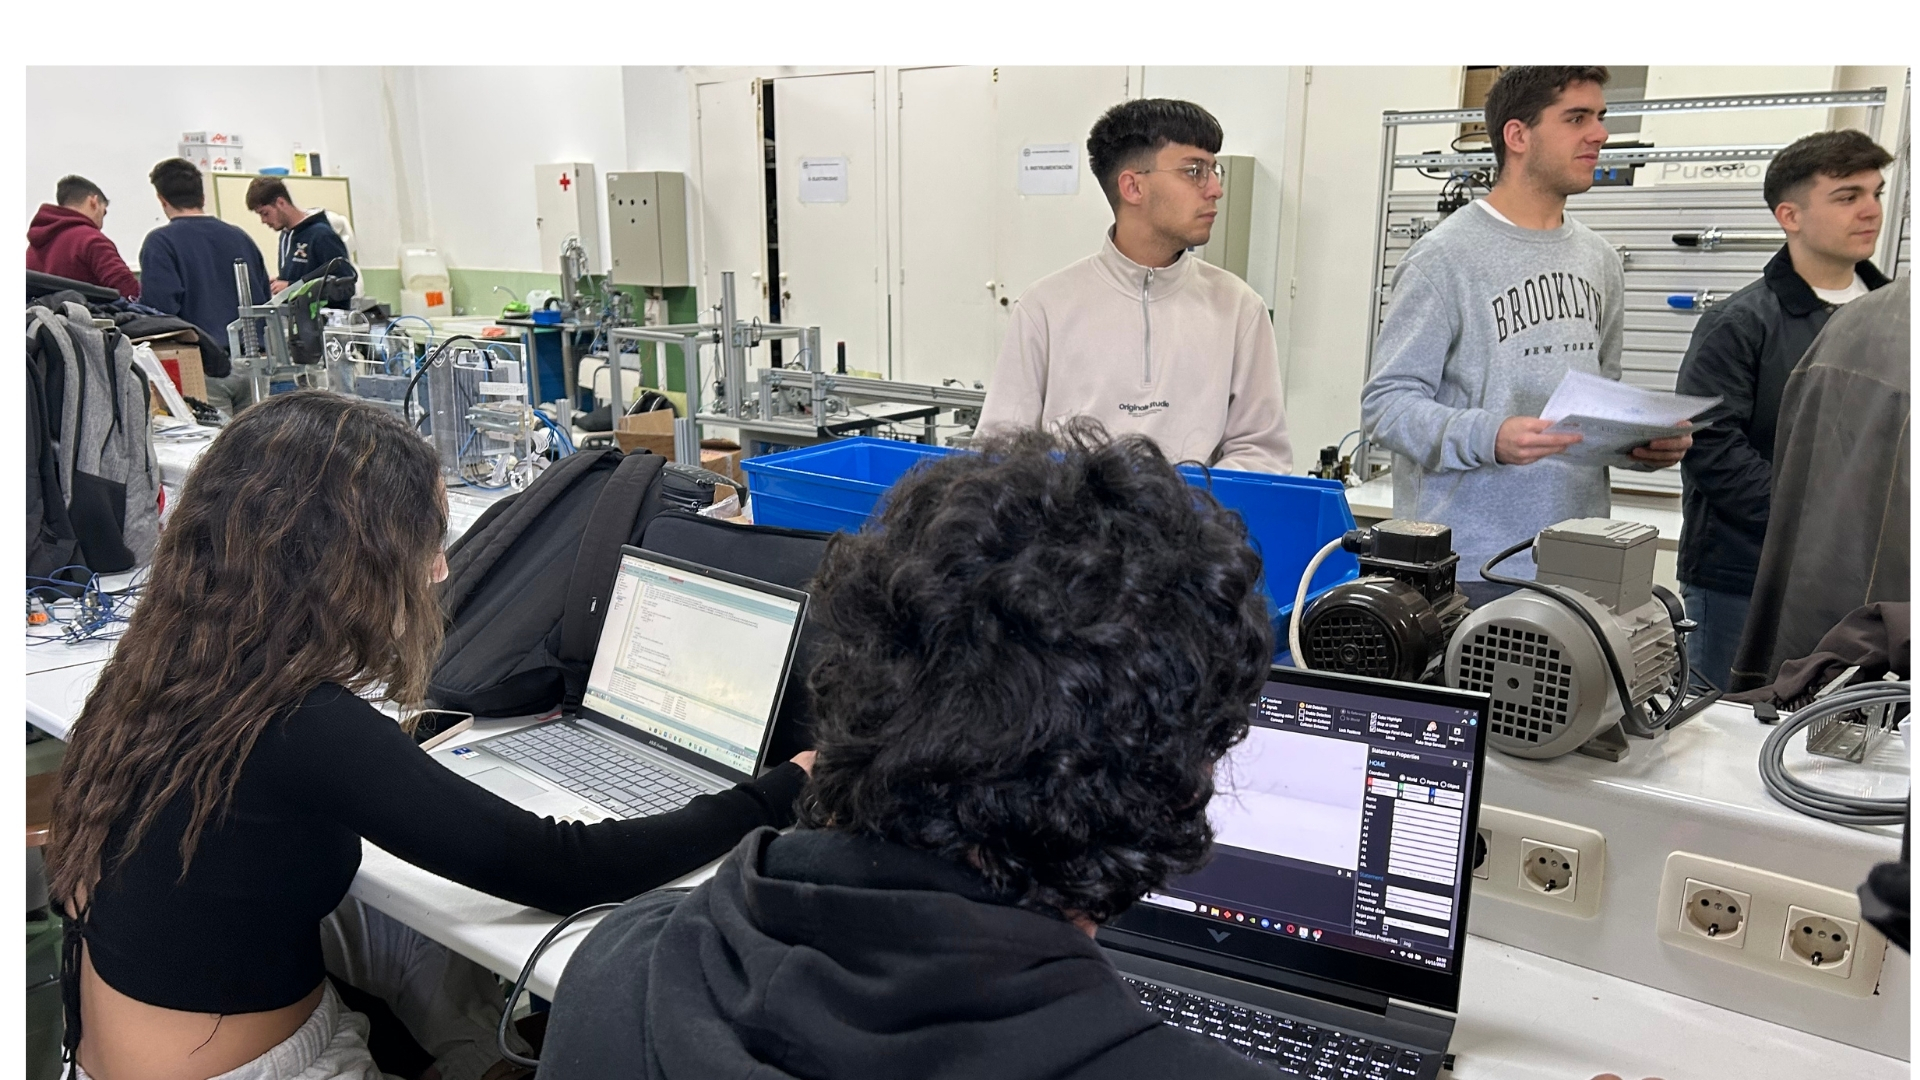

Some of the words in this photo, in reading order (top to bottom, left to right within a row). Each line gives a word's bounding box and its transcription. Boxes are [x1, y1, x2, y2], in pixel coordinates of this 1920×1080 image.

[1661, 162, 1761, 180] Puesto
[1492, 272, 1602, 343] BROOKLYN
[1524, 345, 1553, 357] NEW
[1563, 342, 1594, 352] YORK
[1371, 747, 1395, 757] Statement
[1395, 750, 1420, 760] Properties
[1369, 759, 1386, 768] HOME
[1368, 769, 1390, 778] Coordinates
[1359, 871, 1384, 881] Statement
[1360, 904, 1375, 913] Frame
[1375, 906, 1386, 915] data
[1354, 929, 1376, 940] Statement
[1376, 934, 1398, 944] Properties
